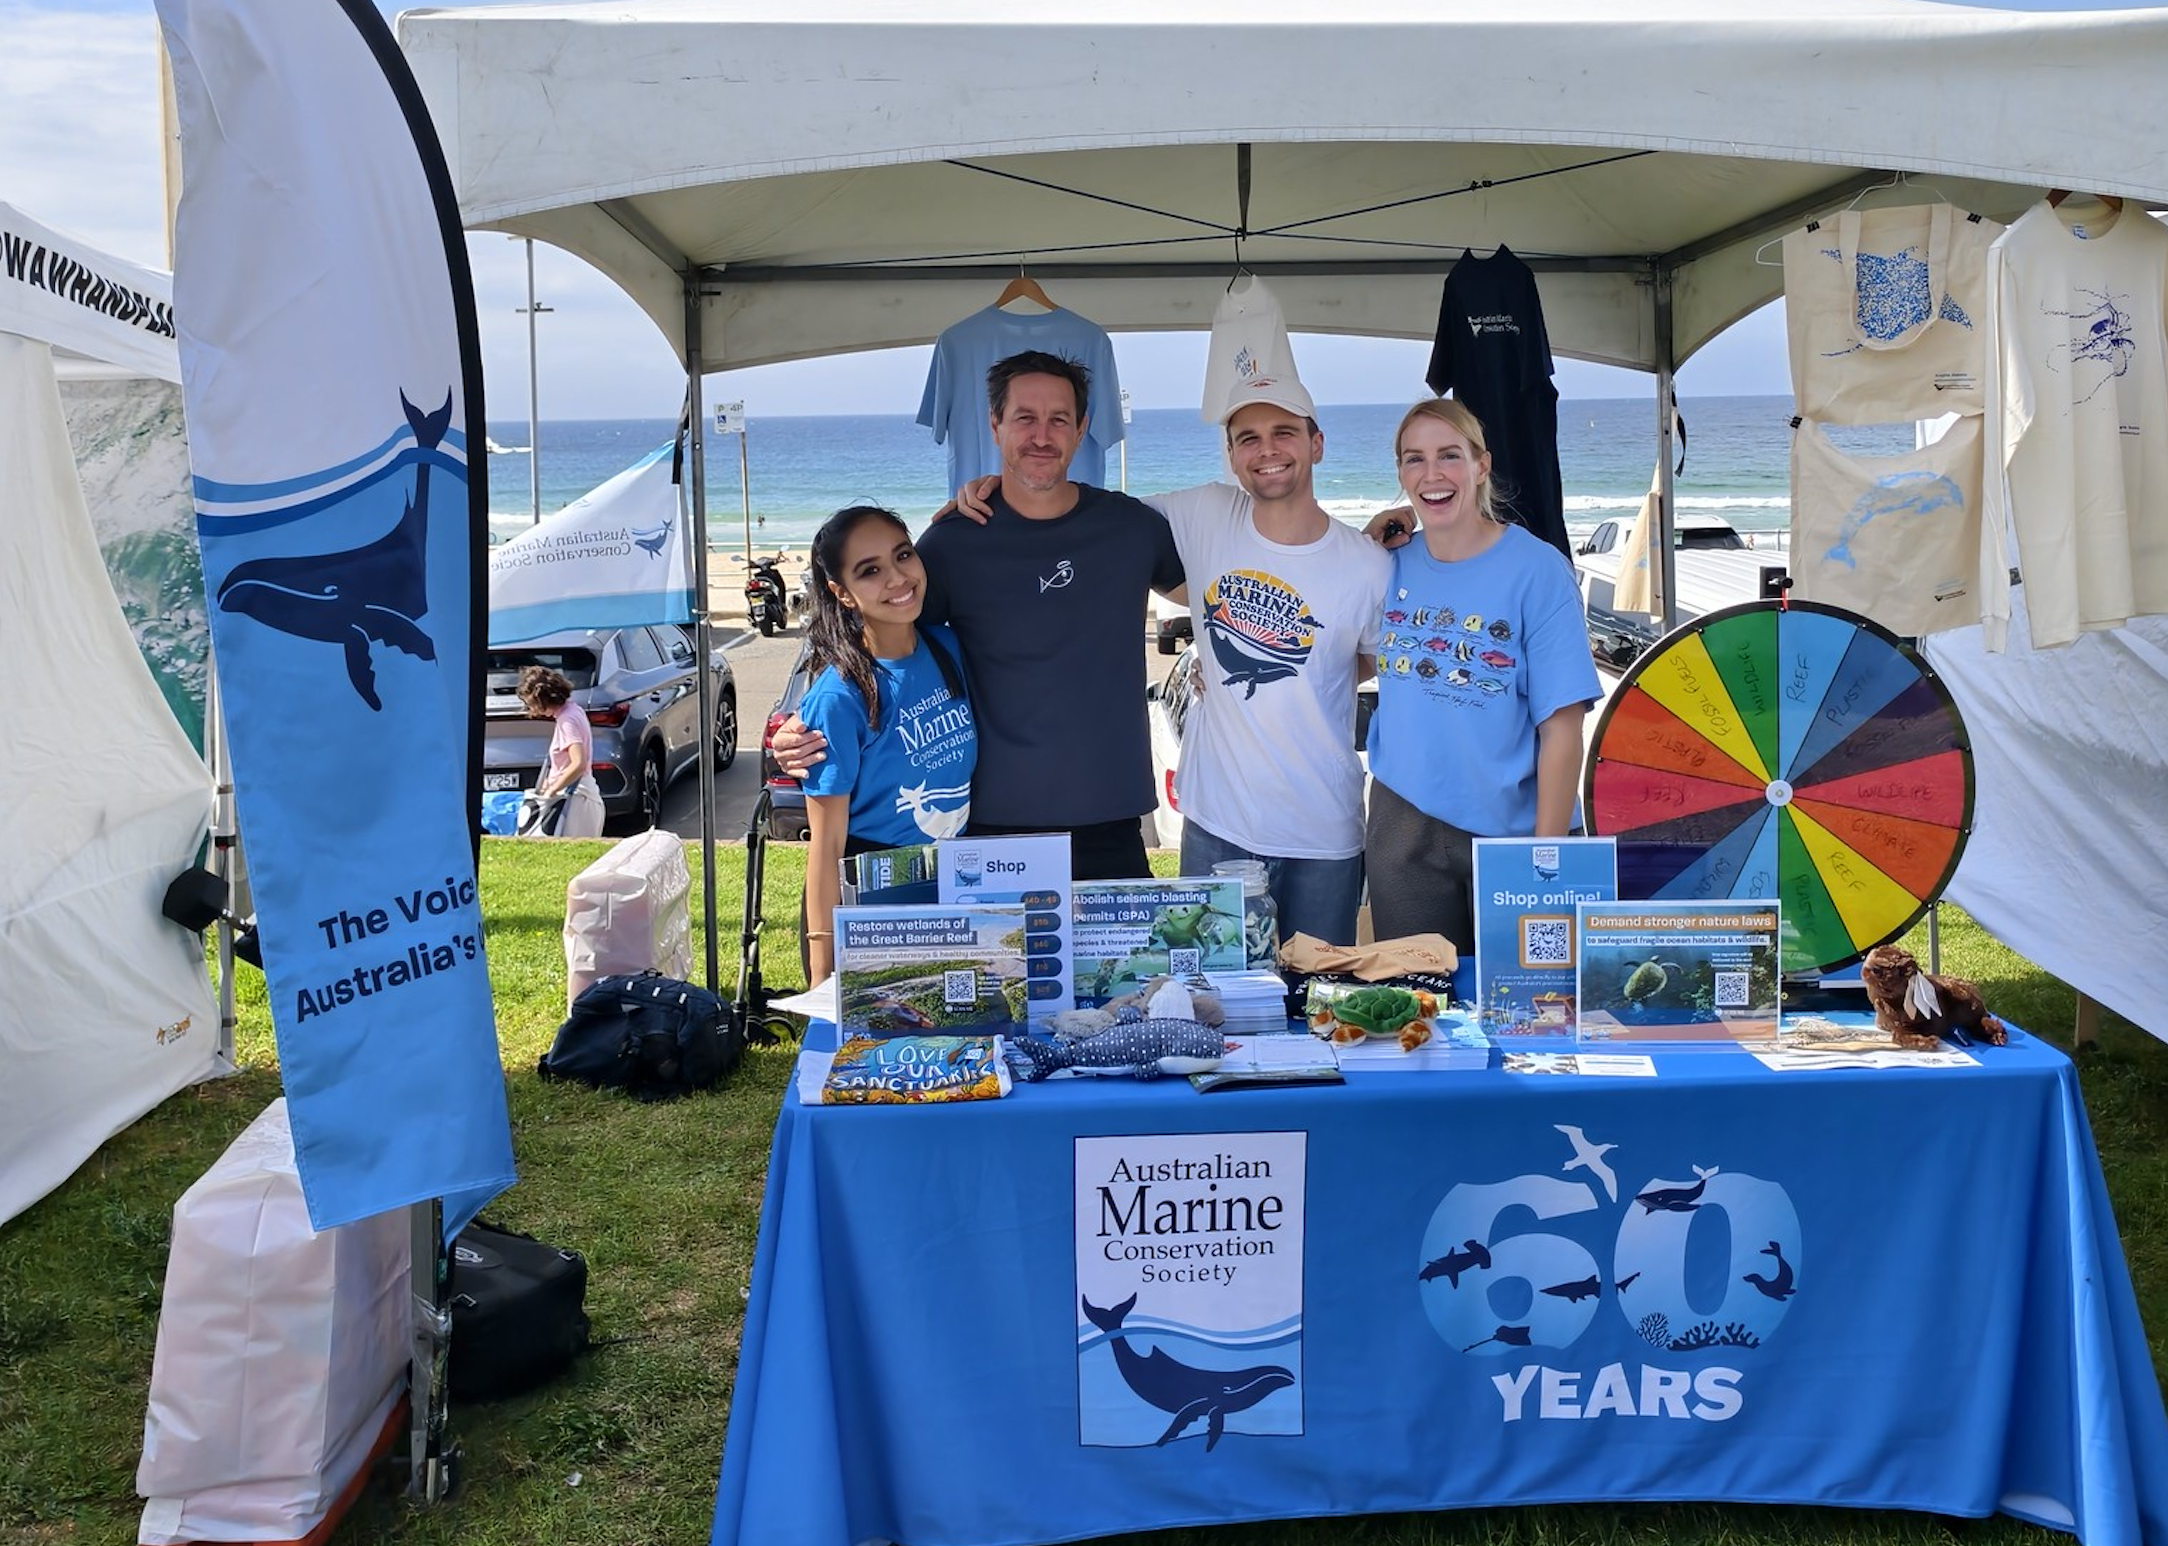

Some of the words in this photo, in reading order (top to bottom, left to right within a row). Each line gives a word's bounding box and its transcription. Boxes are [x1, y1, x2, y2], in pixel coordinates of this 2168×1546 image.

[0, 230, 176, 339] WAWHANDPLA
[1217, 584, 1300, 621] MARINE
[1219, 575, 1304, 608] AUSTRALIAN
[1229, 599, 1311, 637] CONSERVATION
[1230, 609, 1289, 637] SOCIETY
[1784, 652, 1812, 703] REEF
[899, 687, 954, 724] Australia
[1826, 666, 1877, 728] PLASTIC
[894, 703, 971, 756] Marine
[910, 730, 976, 767] Conservation
[924, 749, 965, 773] Society
[879, 857, 892, 889] TIDE
[986, 860, 1026, 875] Shop
[1827, 850, 1867, 892] REEF
[1072, 894, 1115, 905] Abolish
[1116, 893, 1160, 904] seismic
[1161, 891, 1207, 904] blasting
[1493, 890, 1539, 909] Shop
[1542, 890, 1601, 905] online!
[318, 909, 390, 950] The
[394, 876, 475, 923] Voic
[849, 921, 894, 932] Restore
[896, 918, 951, 931] wetlands
[953, 918, 967, 929] of
[1117, 910, 1151, 921] (SPA)
[1590, 916, 1641, 927] Demand
[1643, 916, 1698, 930] stronger
[1698, 916, 1740, 926] nature
[1741, 915, 1772, 926] laws
[849, 934, 869, 945] the
[871, 933, 904, 945] Great
[906, 932, 945, 943] Barrier
[947, 931, 974, 942] Reef
[1079, 928, 1107, 937] protect
[1108, 927, 1151, 936] endangered
[1100, 938, 1107, 946] &
[1107, 937, 1149, 946] threatened
[1597, 936, 1638, 945] safeguard
[1639, 936, 1665, 945] fragile
[1692, 936, 1726, 944] habitats
[1735, 935, 1768, 944] wildlife.
[847, 954, 857, 962] for
[858, 953, 887, 961] cleaner
[888, 951, 931, 961] waterways
[939, 950, 969, 960] healthy
[970, 948, 1020, 958] communities.
[297, 934, 477, 1024] Australia's
[876, 1045, 947, 1066] LOVE
[880, 1063, 945, 1079] OUR
[1108, 1153, 1272, 1183] Australian
[1096, 1183, 1283, 1237] Marine
[1104, 1236, 1275, 1261] Conservation
[1142, 1264, 1237, 1287] Society
[1419, 1172, 1802, 1357] 60
[1491, 1361, 1744, 1422] YEARS
